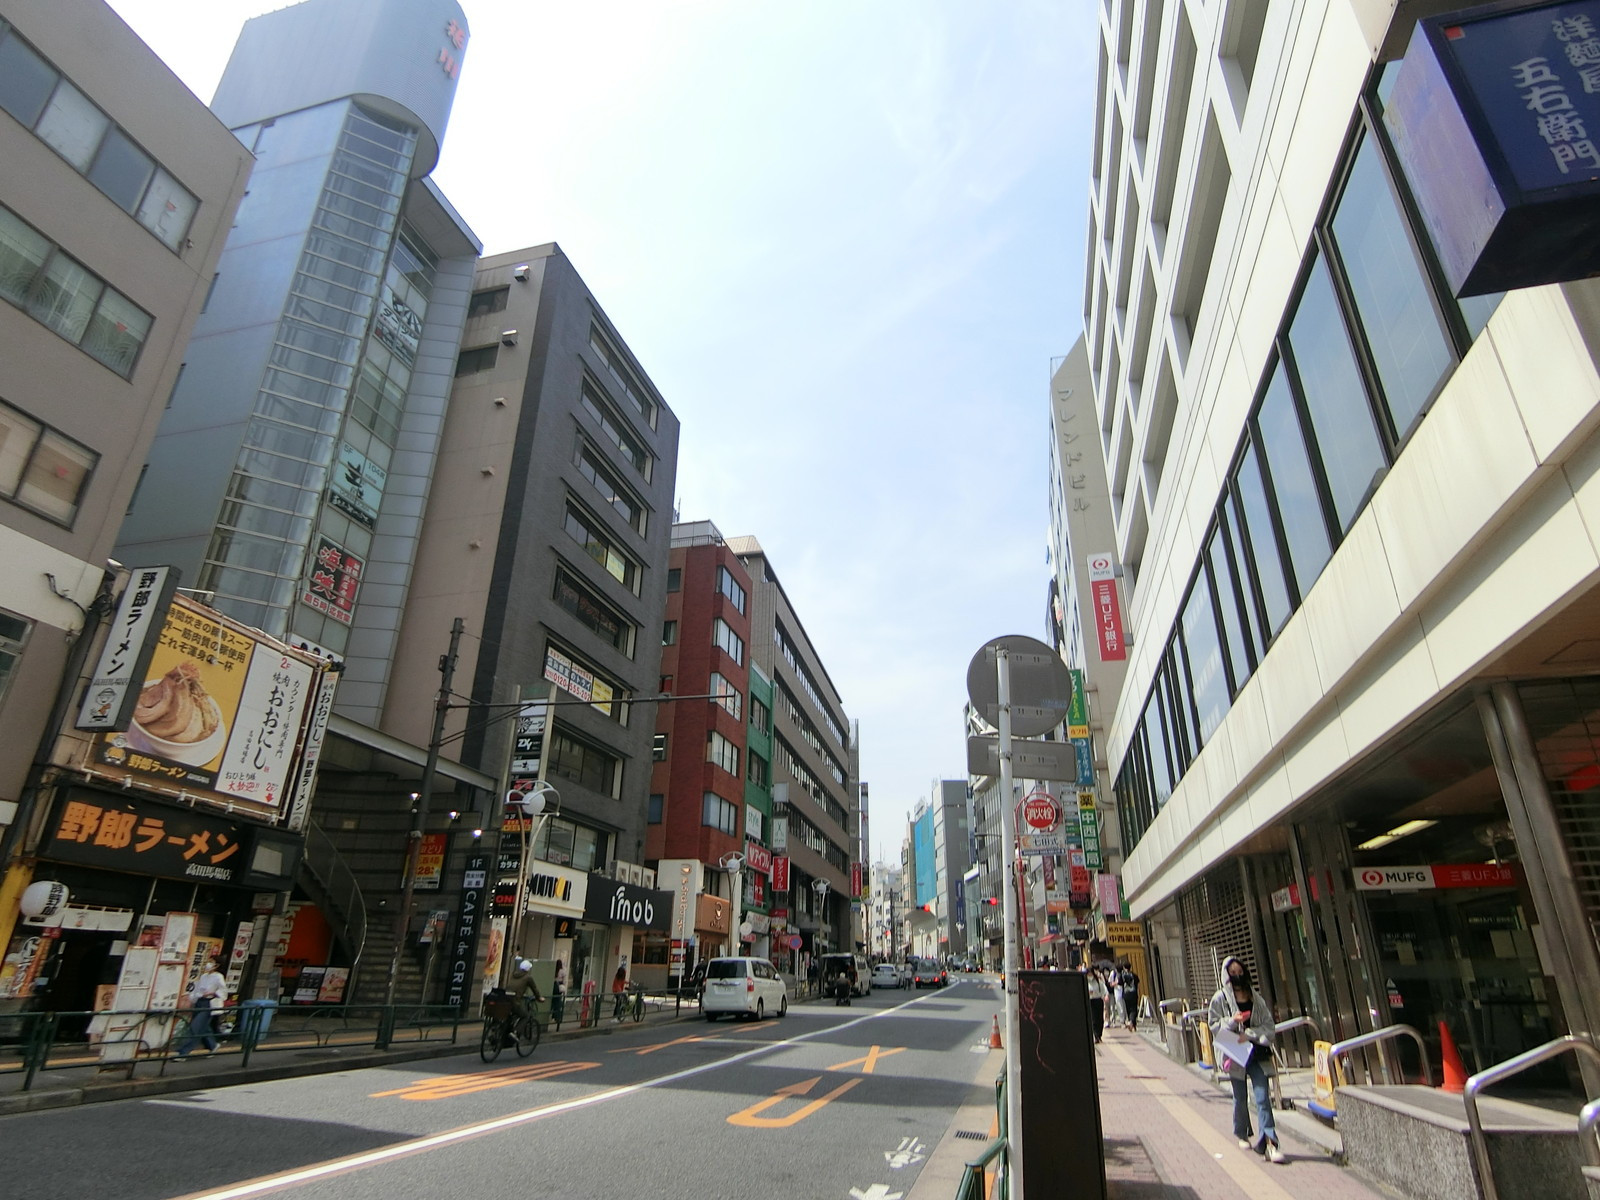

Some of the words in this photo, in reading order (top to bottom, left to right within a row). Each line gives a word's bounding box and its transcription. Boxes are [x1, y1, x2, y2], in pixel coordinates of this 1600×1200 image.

[1509, 56, 1600, 174] 五右衛門
[1058, 387, 1090, 513] フレンドビル
[107, 571, 158, 676] 野郎ラーメン
[1098, 584, 1117, 651] 三菱UFJ銀行
[280, 656, 291, 669] 2F
[253, 685, 285, 771] おおにし
[311, 692, 332, 743] おおにし
[127, 753, 188, 779] 野郎ラーメン
[295, 759, 317, 812] 野郎ラーメン
[1026, 806, 1053, 821] 消火栓
[1079, 794, 1094, 807] 薬
[748, 810, 760, 827] style
[57, 800, 241, 865] 野郎ラーメン
[1081, 811, 1099, 865] 中西薬局
[471, 858, 483, 869] 1F
[754, 847, 770, 869] アイフル
[185, 862, 234, 881] 高田馬場店
[1385, 871, 1426, 883] MUFG
[1450, 869, 1512, 882] 三菱UFJ銀
[459, 889, 477, 938] CAFÉ
[457, 940, 470, 955] de
[1109, 934, 1141, 943] 中西薬局
[448, 959, 467, 1006] CRIÉ
